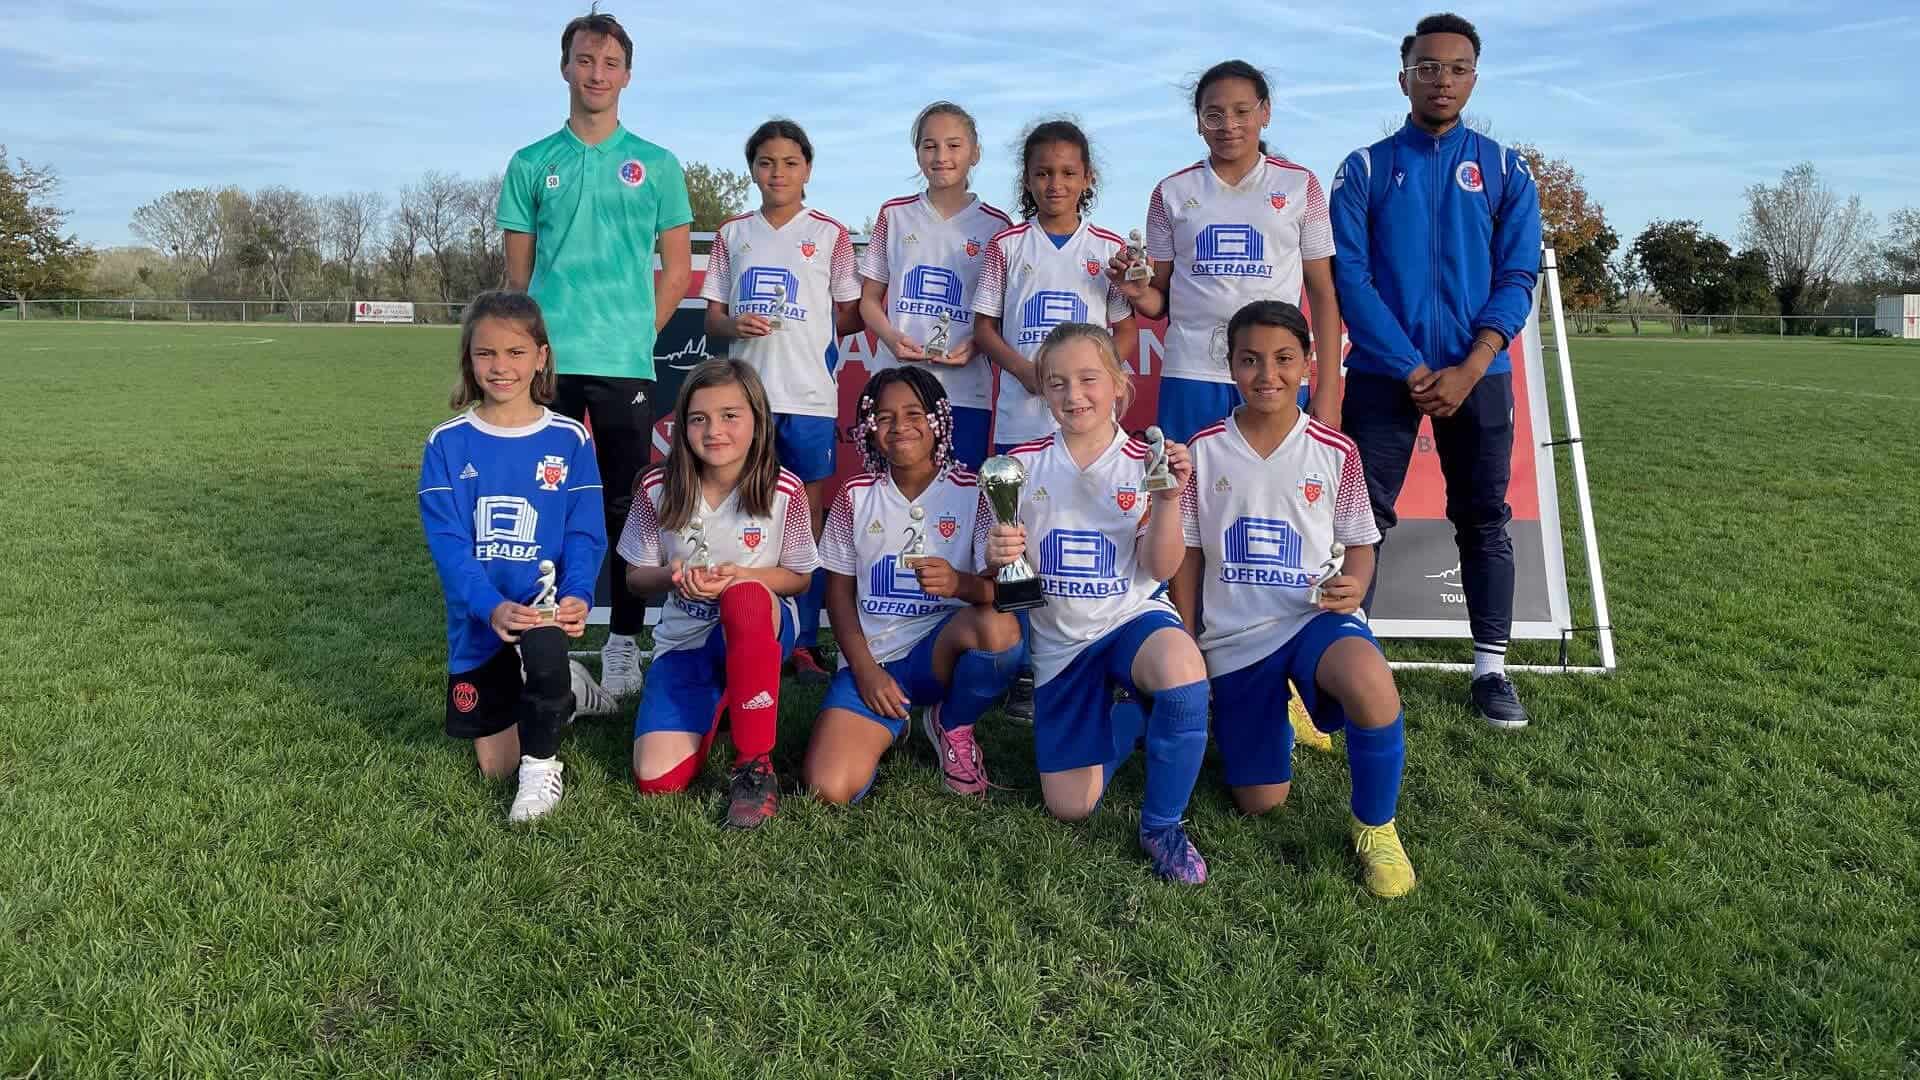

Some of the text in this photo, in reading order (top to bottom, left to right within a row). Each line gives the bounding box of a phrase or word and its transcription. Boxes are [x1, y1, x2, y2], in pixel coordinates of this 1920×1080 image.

[1191, 263, 1273, 276] COFFRABAT
[735, 303, 808, 319] OFFRAAT
[1220, 567, 1320, 585] OFFRABAT
[1440, 593, 1467, 604] TOU
